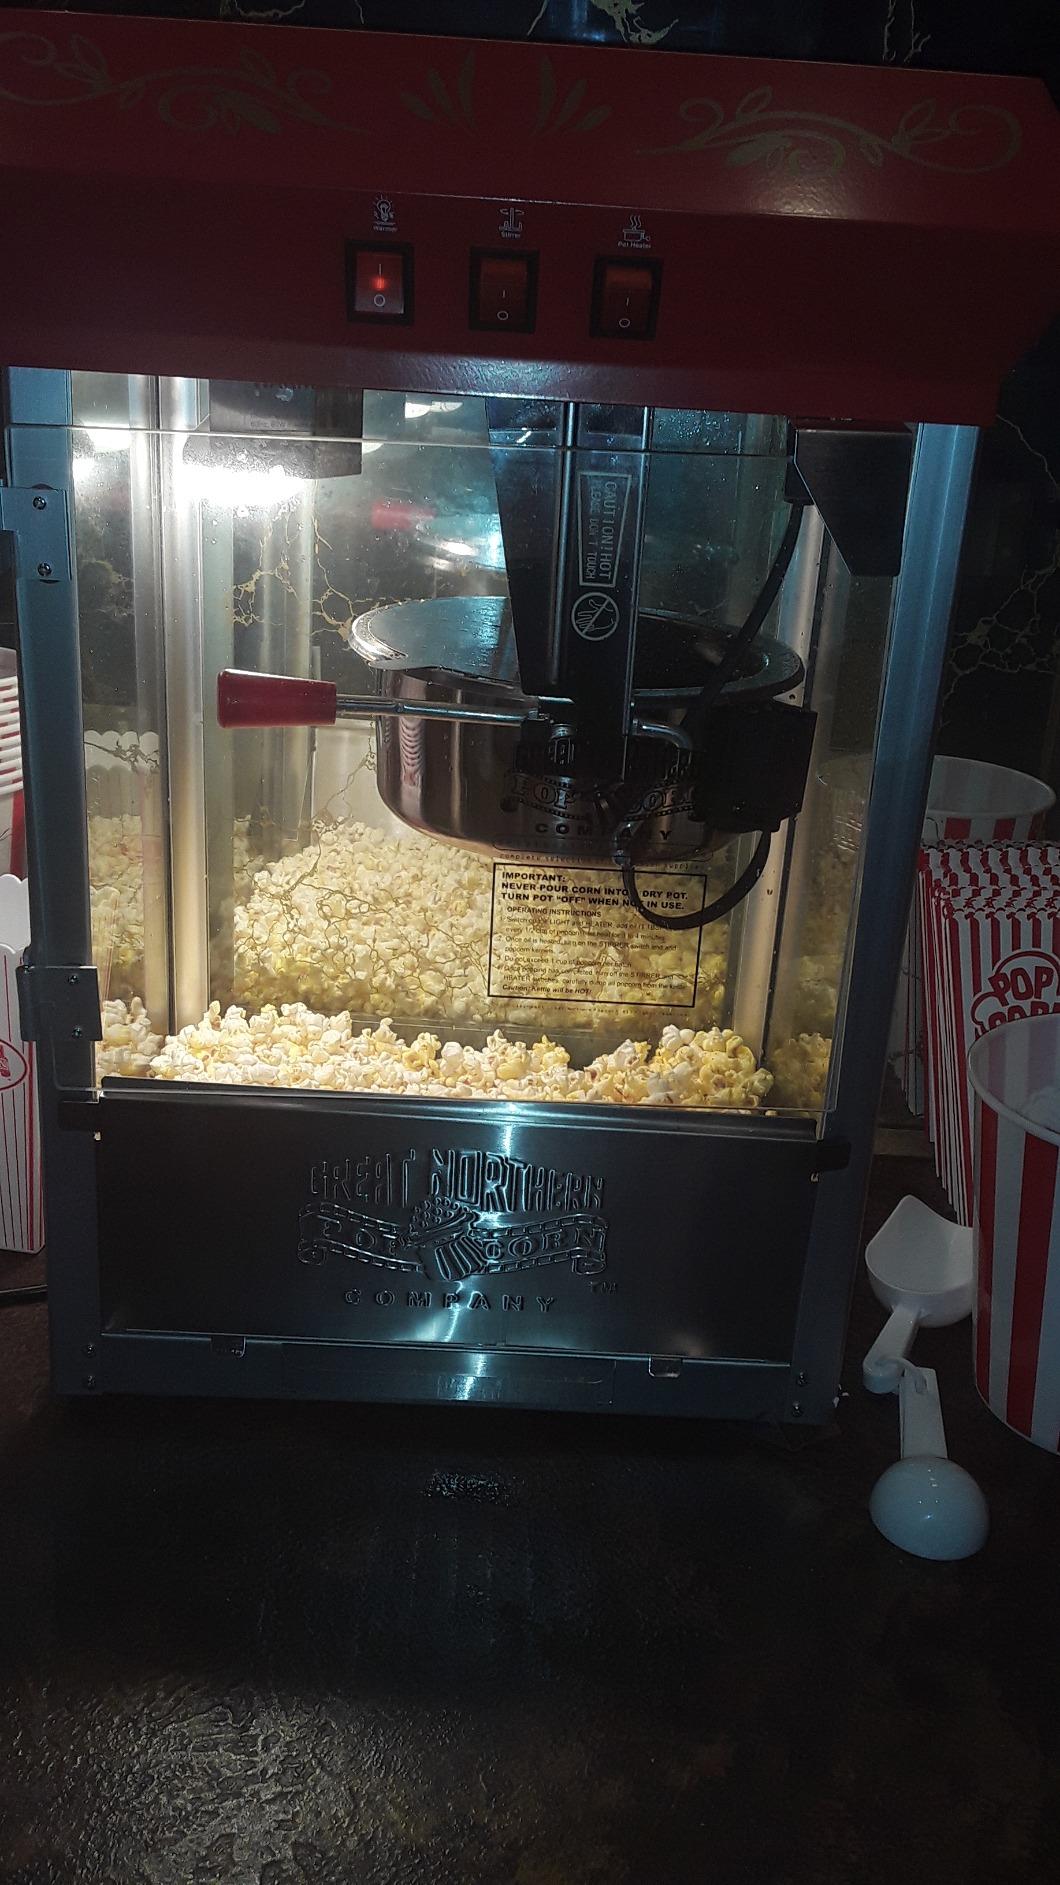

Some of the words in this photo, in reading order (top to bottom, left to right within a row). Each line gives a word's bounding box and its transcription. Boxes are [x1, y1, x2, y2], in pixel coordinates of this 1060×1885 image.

[585, 551, 598, 580] TOUCH
[502, 872, 566, 883] IMPORTANT:
[501, 892, 529, 900] TURN
[588, 898, 619, 906] WHEN
[661, 902, 684, 910] USE.
[502, 882, 536, 891] NEVER
[540, 885, 568, 893] POUR
[572, 886, 601, 894] CORN
[642, 890, 663, 899] DRY
[666, 892, 688, 900] POT.
[506, 906, 548, 915] OPERATING
[549, 909, 602, 918] INSTRUCTIONS
[988, 966, 1054, 1006] POP
[310, 1148, 416, 1209] GREAT
[430, 1148, 607, 1212] NORTHERN
[344, 1288, 556, 1313] COMPANY
